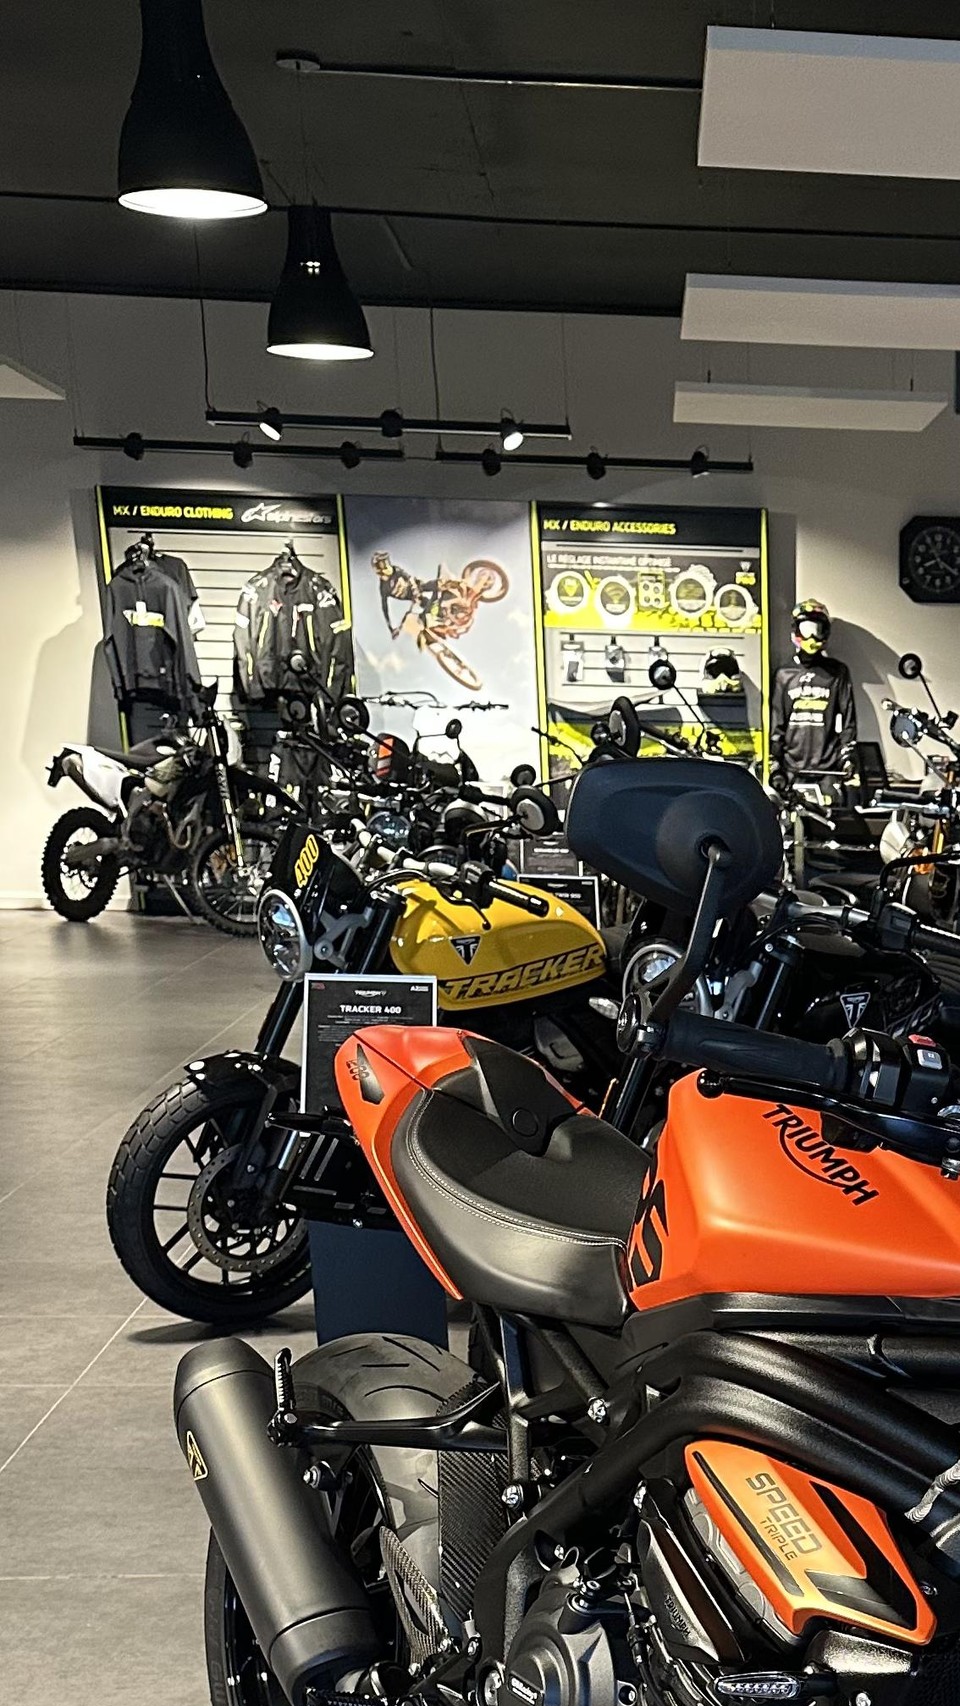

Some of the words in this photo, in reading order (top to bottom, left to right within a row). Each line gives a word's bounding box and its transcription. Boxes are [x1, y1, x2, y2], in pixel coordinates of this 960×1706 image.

[113, 505, 130, 516] MX
[140, 506, 182, 518] ENDURO
[184, 507, 234, 520] CLOTHING
[543, 519, 560, 530] MX
[570, 520, 611, 532] ENDURO
[612, 522, 677, 535] ACCESSORIES
[294, 834, 319, 888] 400
[446, 943, 604, 1000] TRACKER
[340, 1004, 382, 1013] TRACKER
[383, 1006, 402, 1014] 400
[762, 1103, 880, 1206] TRIUMPH
[745, 1472, 822, 1555] SPEED
[759, 1515, 798, 1561] TRIPLE
[664, 1593, 692, 1638] TRIUMPH
